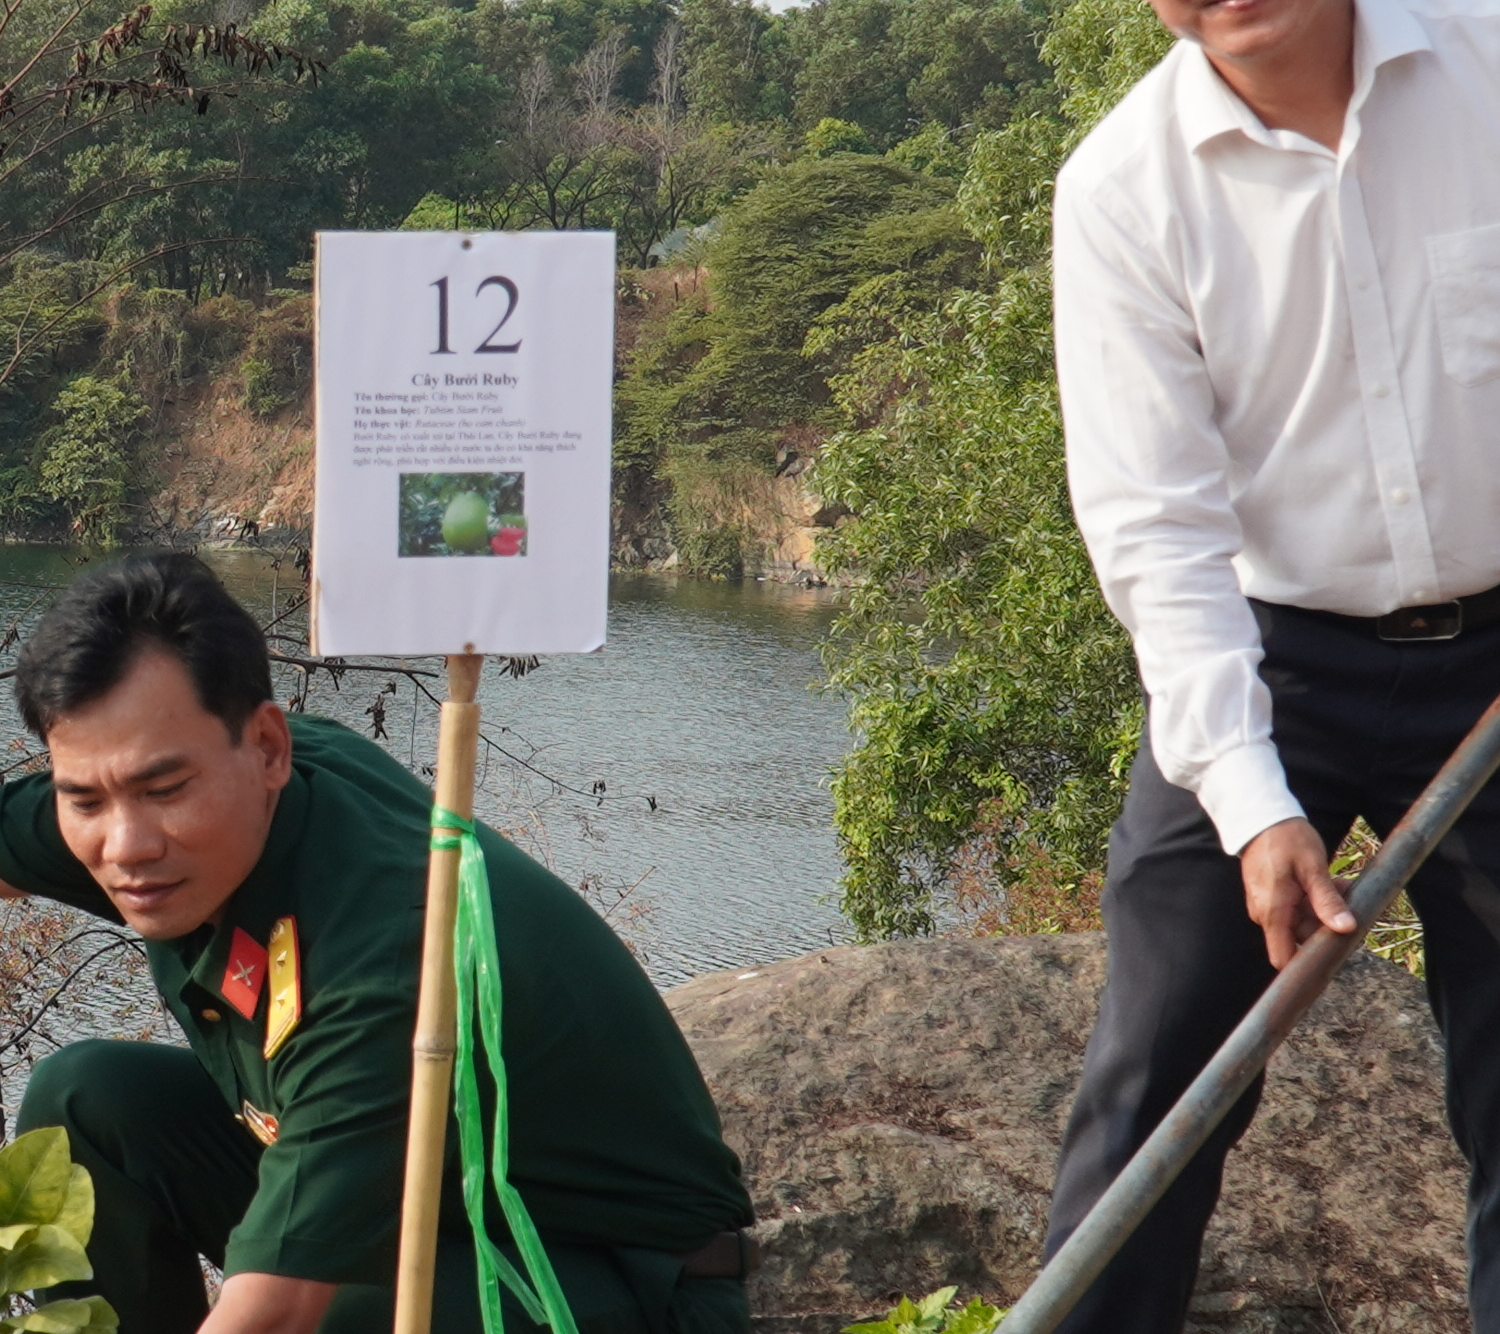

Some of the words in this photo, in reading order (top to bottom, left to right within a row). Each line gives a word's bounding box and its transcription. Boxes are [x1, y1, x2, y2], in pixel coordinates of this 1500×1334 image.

[428, 274, 523, 355] 12
[412, 373, 439, 389] Cây
[483, 373, 519, 389] Ruby
